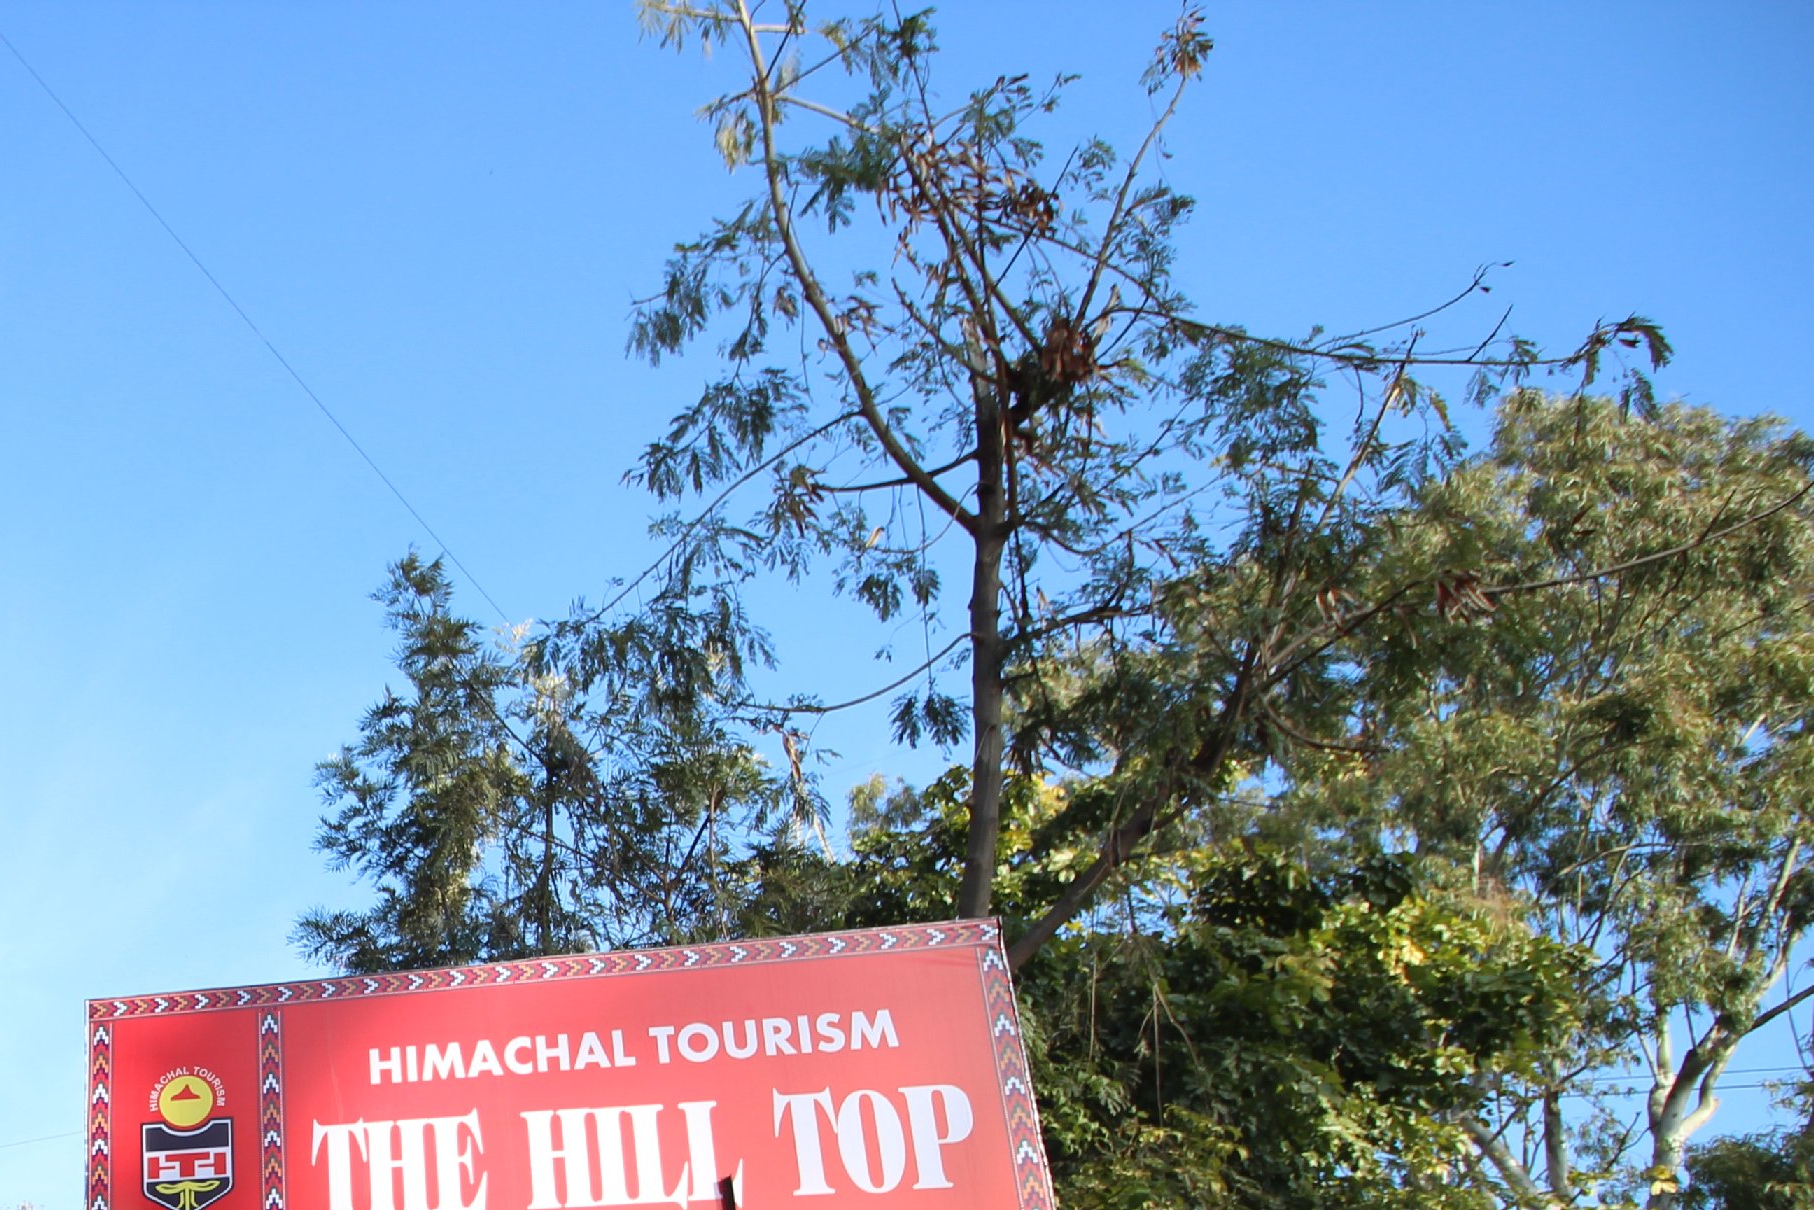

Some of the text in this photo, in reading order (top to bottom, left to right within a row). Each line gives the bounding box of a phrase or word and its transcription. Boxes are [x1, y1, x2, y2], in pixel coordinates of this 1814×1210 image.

[369, 1009, 900, 1085] HIMACHAL TOURISM
[149, 1066, 226, 1112] HIMACHAL TOURISM
[771, 1083, 975, 1197] TOP
